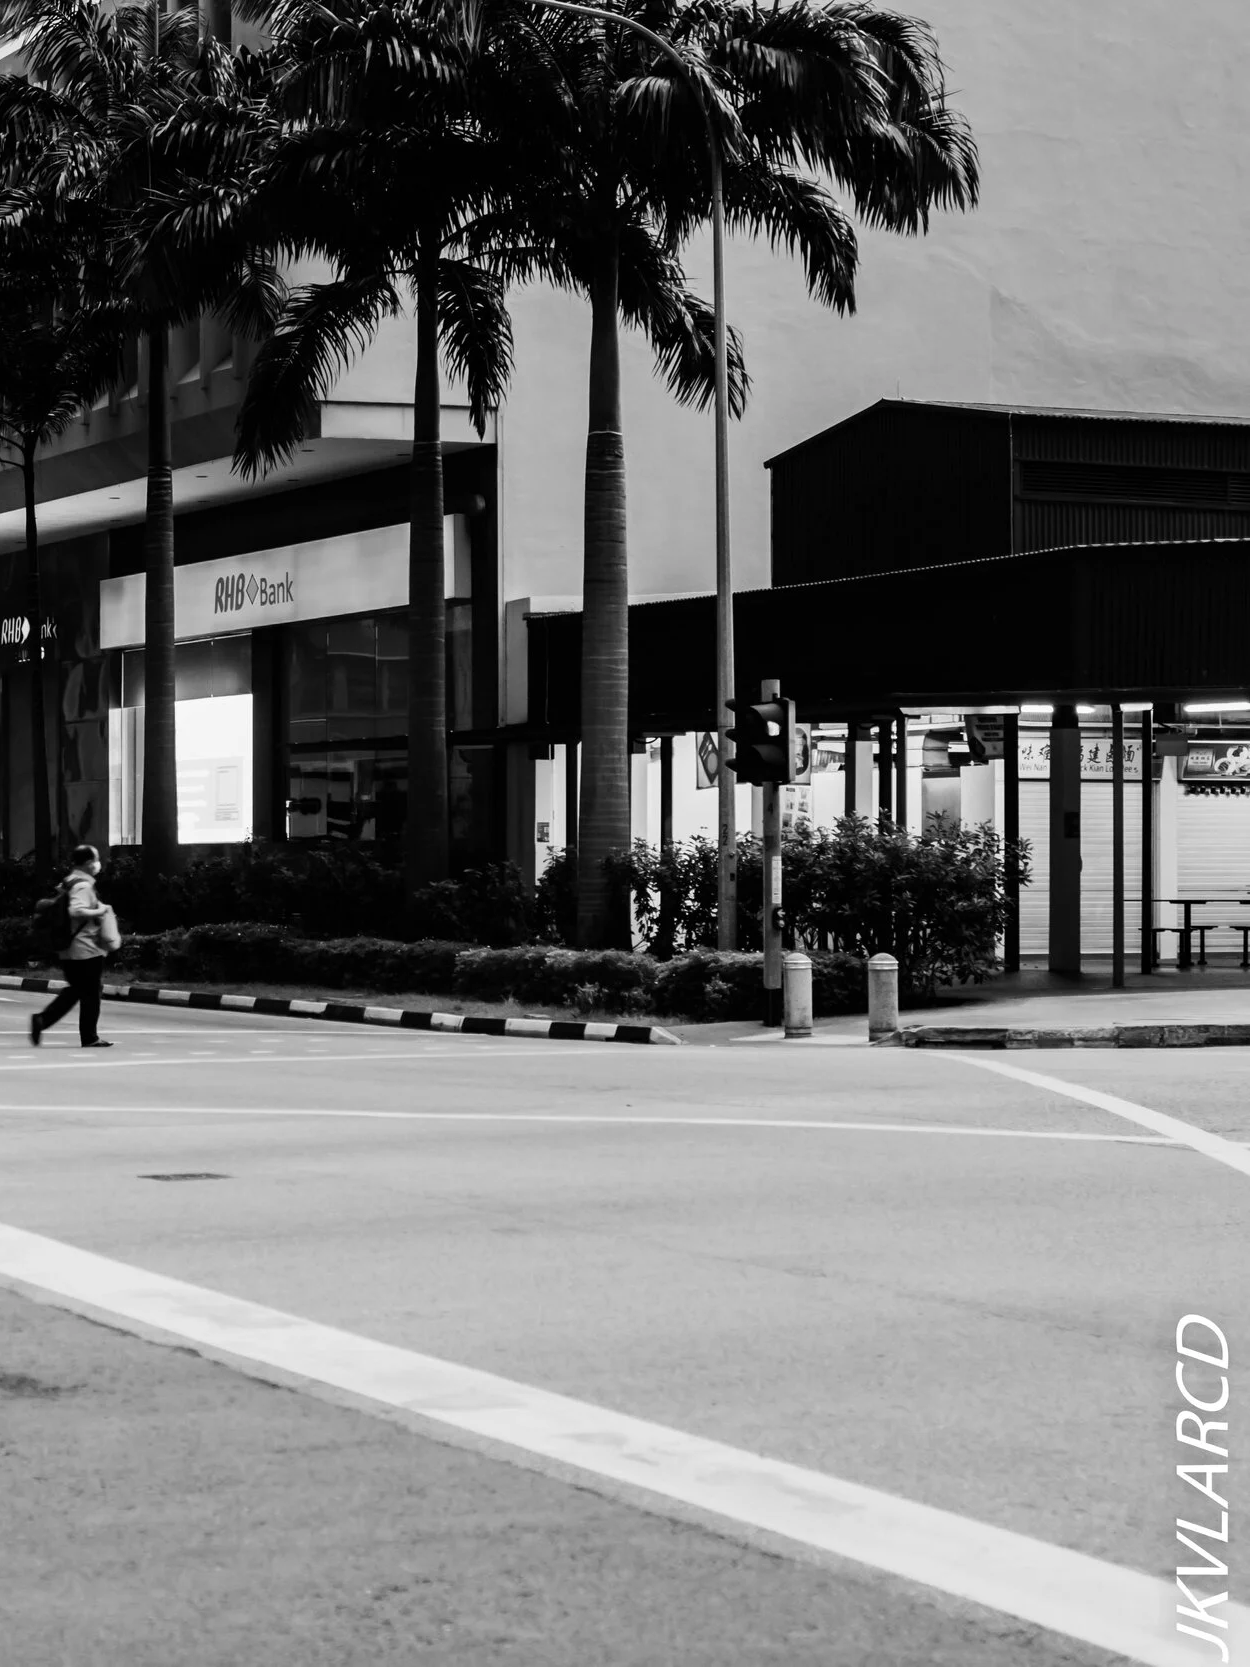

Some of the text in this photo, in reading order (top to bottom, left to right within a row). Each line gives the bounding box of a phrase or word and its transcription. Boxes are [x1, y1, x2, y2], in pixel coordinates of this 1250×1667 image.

[214, 571, 294, 614] RHB Bank
[1, 616, 21, 645] RHB
